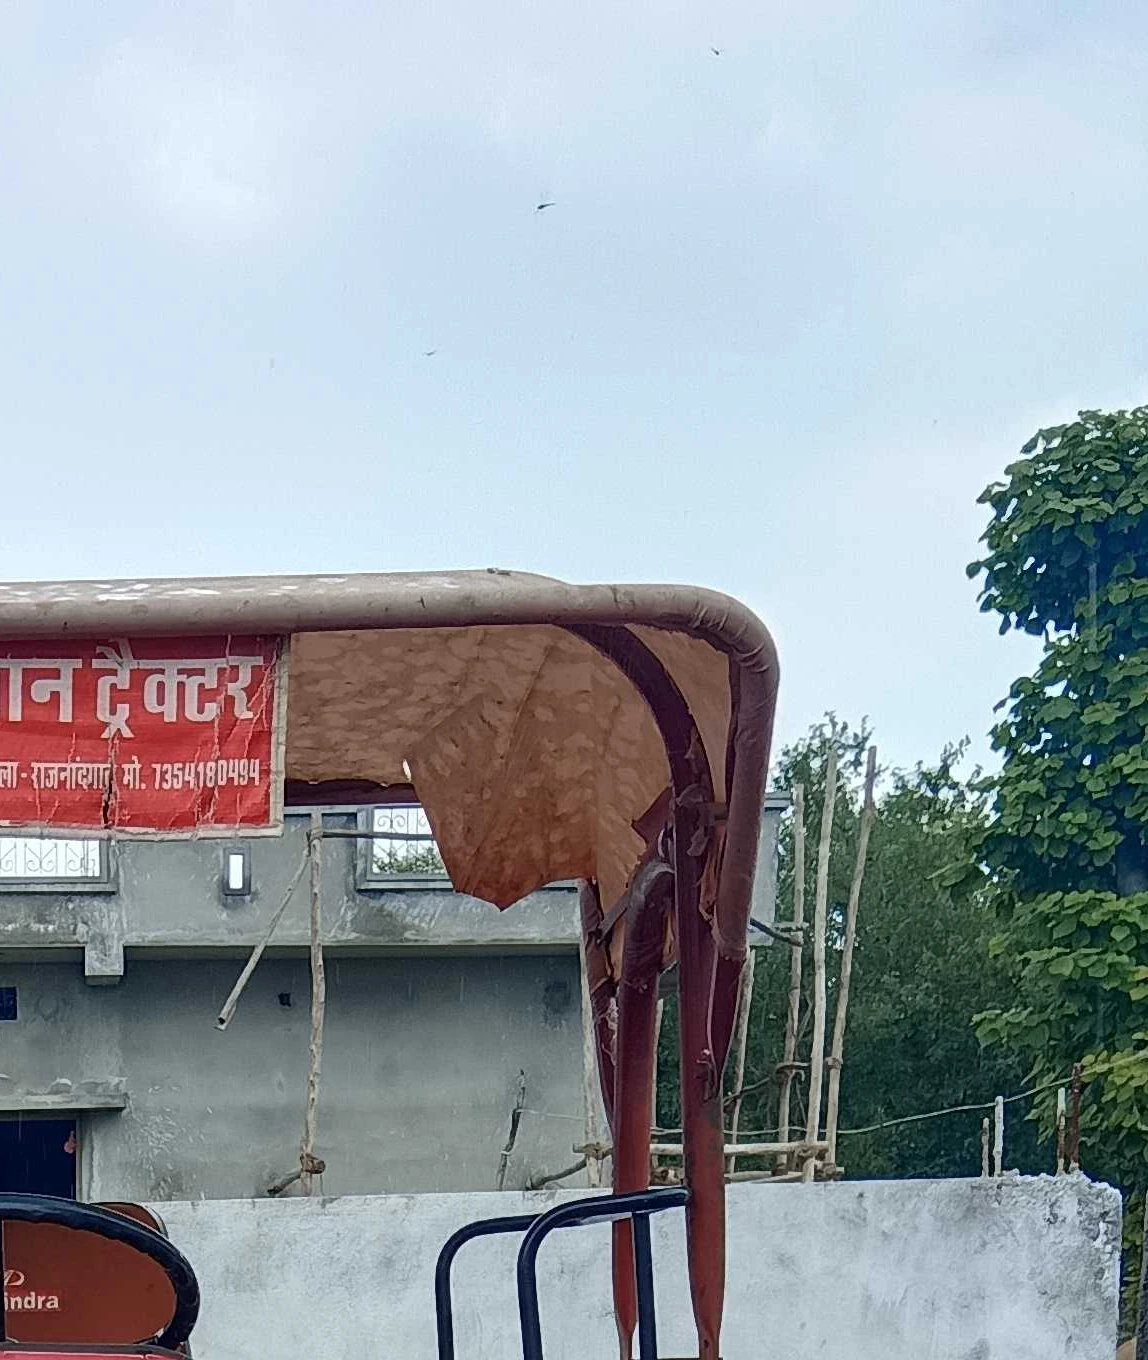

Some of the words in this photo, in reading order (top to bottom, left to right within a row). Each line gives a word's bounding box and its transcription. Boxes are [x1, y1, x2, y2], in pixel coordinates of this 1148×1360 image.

[92, 638, 263, 738] ट्रैक्टर
[122, 755, 146, 790] मो.
[151, 758, 260, 790] 7354180494
